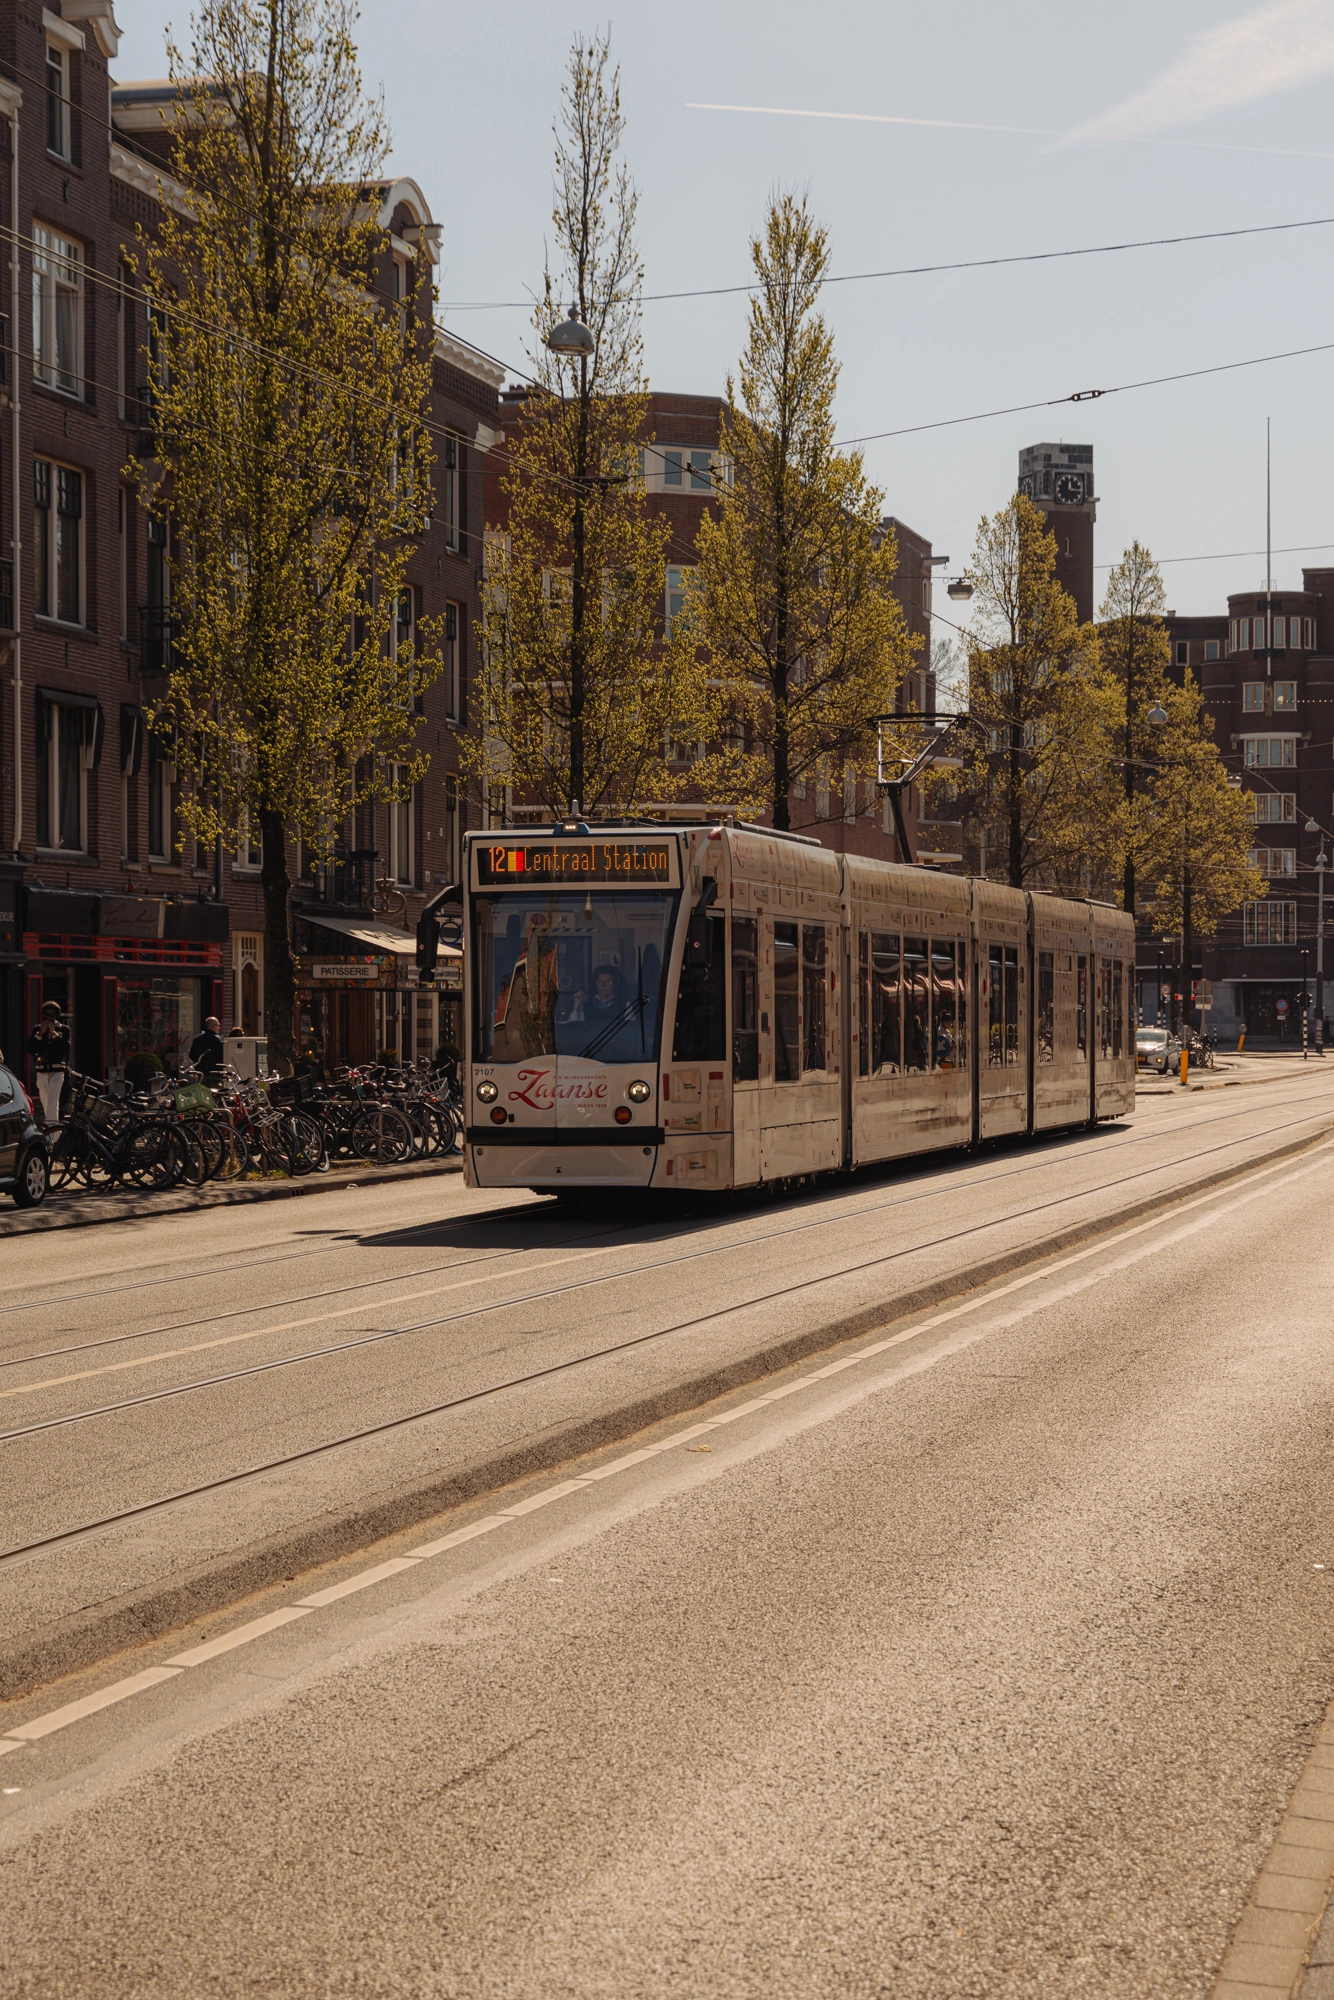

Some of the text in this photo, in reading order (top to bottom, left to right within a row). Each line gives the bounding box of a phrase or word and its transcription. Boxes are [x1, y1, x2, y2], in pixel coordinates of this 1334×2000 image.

[488, 846, 506, 872] 12
[524, 844, 596, 871] Centraal
[604, 843, 667, 871] Station
[320, 967, 370, 976] PATISSERIE
[127, 980, 149, 988] KINKI
[474, 1068, 495, 1076] 2107
[508, 1069, 608, 1110] Zaanse
